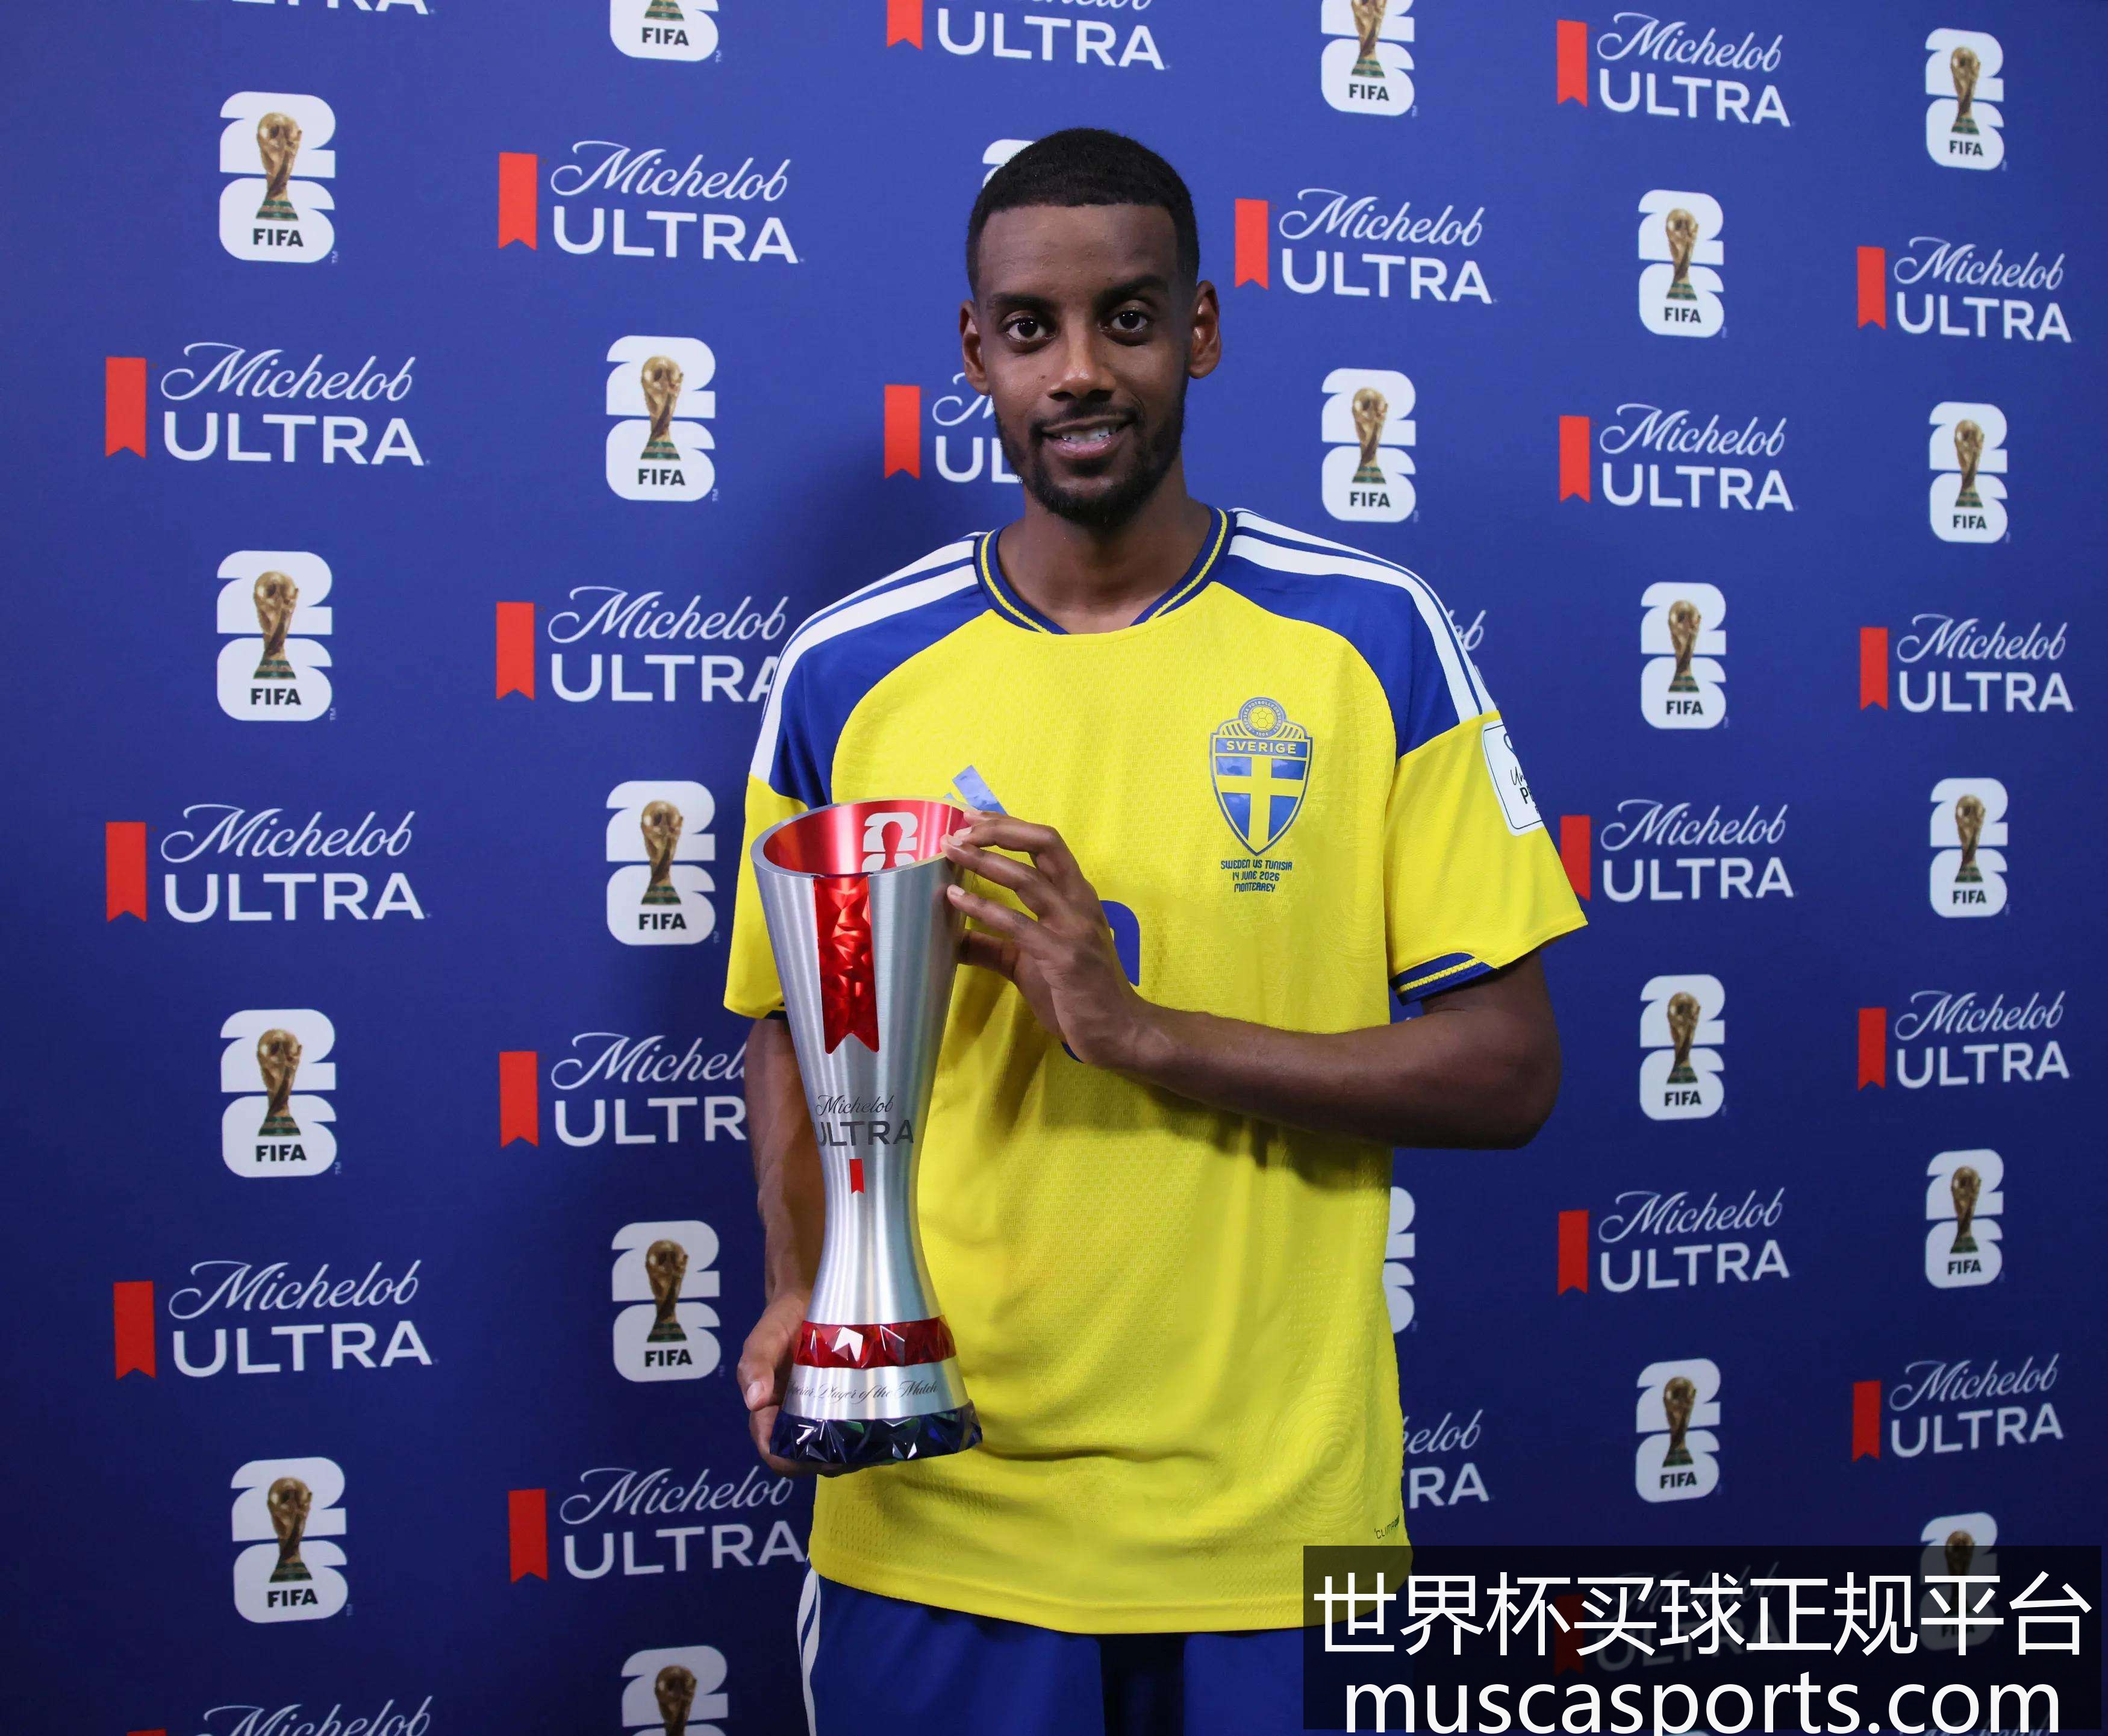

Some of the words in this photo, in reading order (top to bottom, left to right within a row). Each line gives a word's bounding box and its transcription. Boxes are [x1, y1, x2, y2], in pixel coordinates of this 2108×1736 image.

[643, 28, 688, 46] FIFA
[938, 8, 1165, 70] ULTRA
[1597, 12, 1783, 72] Michelob
[1350, 84, 1389, 101] FIFA
[1600, 69, 1790, 126] ULTRA
[550, 141, 790, 201] Michelob
[1950, 140, 1983, 156] FIFA
[254, 228, 303, 246] FIFA
[554, 206, 798, 263] ULTRA
[1279, 189, 1484, 246] Michelob
[1282, 248, 1492, 304] ULTRA
[1894, 237, 2065, 290] Michelob
[1665, 307, 1701, 323] FIFA
[1897, 292, 2071, 343] ULTRA
[161, 342, 415, 401] Michelob
[164, 411, 424, 466] ULTRA
[1600, 404, 1786, 456] Michelob
[638, 469, 685, 486] FIFA
[1350, 492, 1390, 507] FIFA
[1603, 463, 1794, 511] ULTRA
[1953, 515, 1986, 529] FIFA
[548, 586, 788, 643] Michelob
[1897, 614, 2067, 663] Michelob
[251, 688, 301, 705] FIFA
[1667, 701, 1703, 714] FIFA
[1900, 671, 2074, 712] ULTRA
[1226, 740, 1297, 754] SVERIGE
[161, 804, 414, 863] Michelob
[1601, 799, 1788, 851] Michelob
[1221, 859, 1250, 869] SWEDEN
[1265, 860, 1293, 871] TUNISIA
[1234, 882, 1276, 893] MONTERREY
[1241, 871, 1258, 881] JUNE
[1259, 872, 1280, 881] 2026
[1603, 857, 1794, 902] ULTRA
[165, 873, 425, 922] ULTRA
[640, 913, 687, 929] FIFA
[1953, 890, 1986, 904] FIFA
[1895, 991, 2065, 1040] Michelob
[551, 1032, 747, 1090] Michel
[1897, 1041, 2069, 1088] ULTRA
[555, 1096, 747, 1147] ULTR
[815, 1094, 894, 1116] Michelob
[1665, 1091, 1701, 1106] FIFA
[256, 1144, 306, 1161] FIFA
[1599, 1188, 1784, 1243] Michelob
[169, 1260, 420, 1319] Michelob
[1601, 1240, 1789, 1293] ULTRA
[1948, 1260, 1981, 1275] FIFA
[173, 1321, 432, 1377] ULTRA
[646, 1349, 692, 1367] FIFA
[854, 1385, 879, 1404] of
[873, 1387, 891, 1399] the
[898, 1379, 938, 1398] Match
[1890, 1354, 2059, 1411] Michelob
[1892, 1403, 2063, 1457] ULTRA
[1661, 1472, 1697, 1488] FIFA
[564, 1521, 805, 1579] ULTRA
[268, 1589, 317, 1607] FIFA
